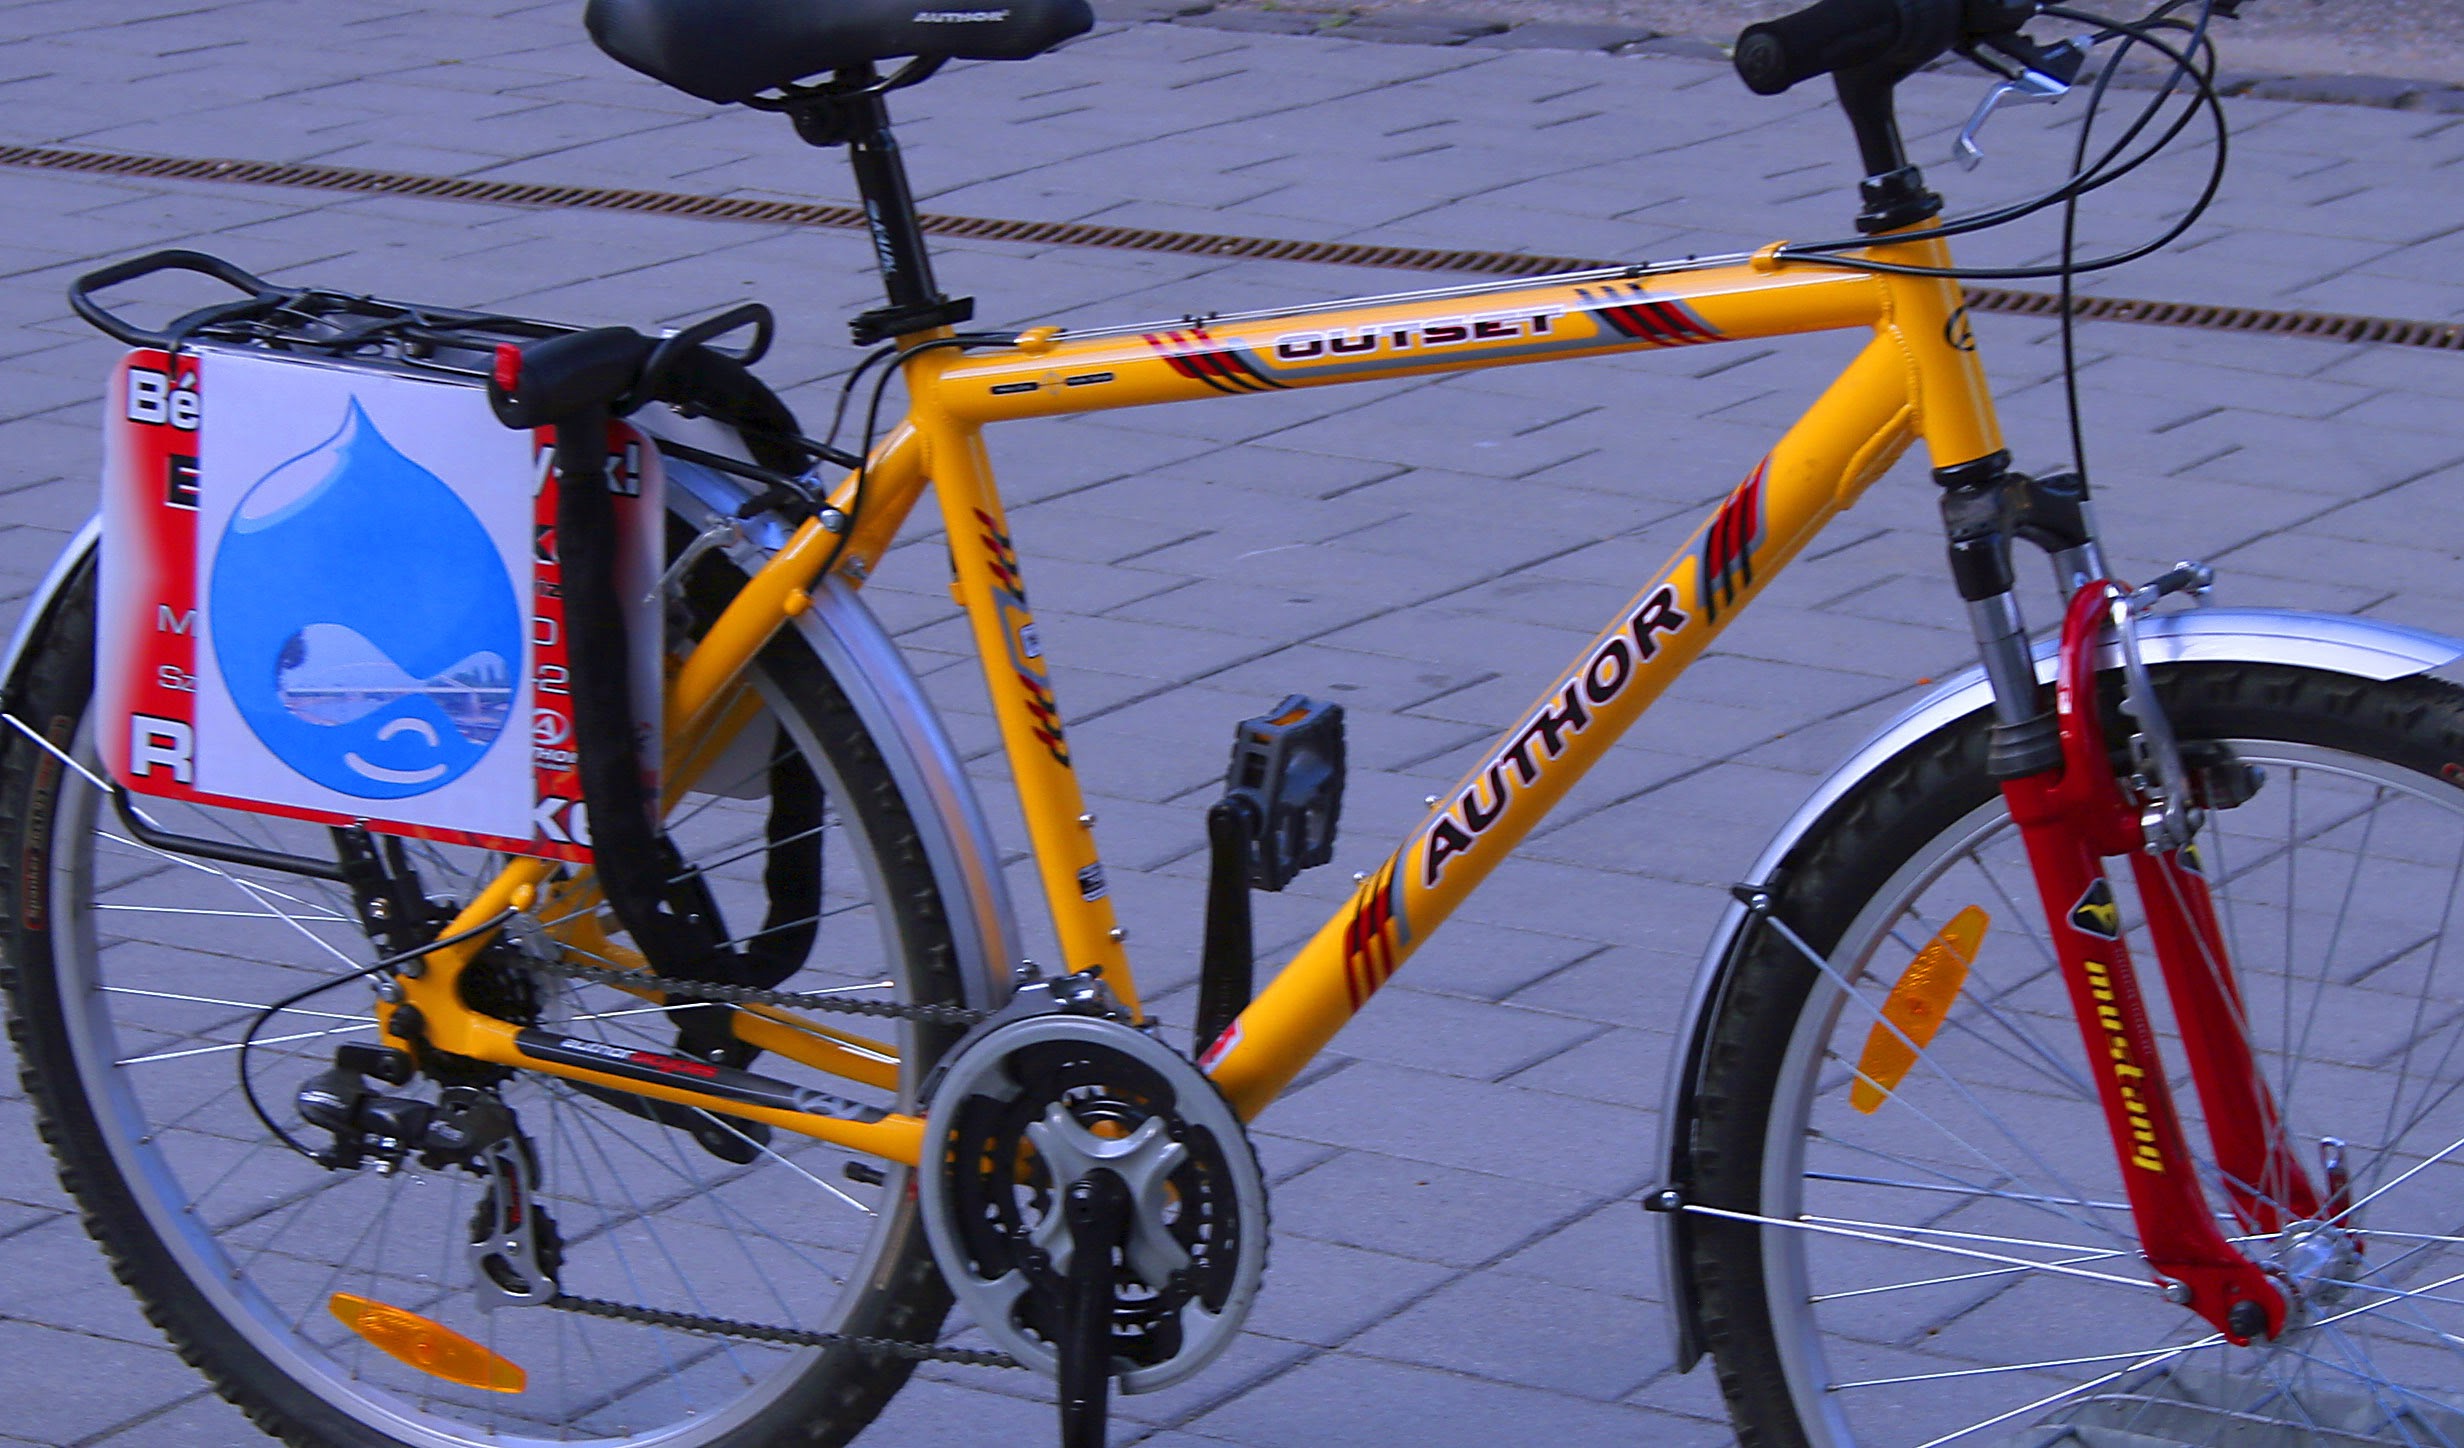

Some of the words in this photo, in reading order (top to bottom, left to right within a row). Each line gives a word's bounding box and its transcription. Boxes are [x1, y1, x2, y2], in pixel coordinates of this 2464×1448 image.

[912, 10, 1006, 23] AUTHOR
[1275, 306, 1563, 361] OUTSET
[1421, 583, 1688, 888] AUTHOR
[2086, 961, 2163, 1173] mustang
